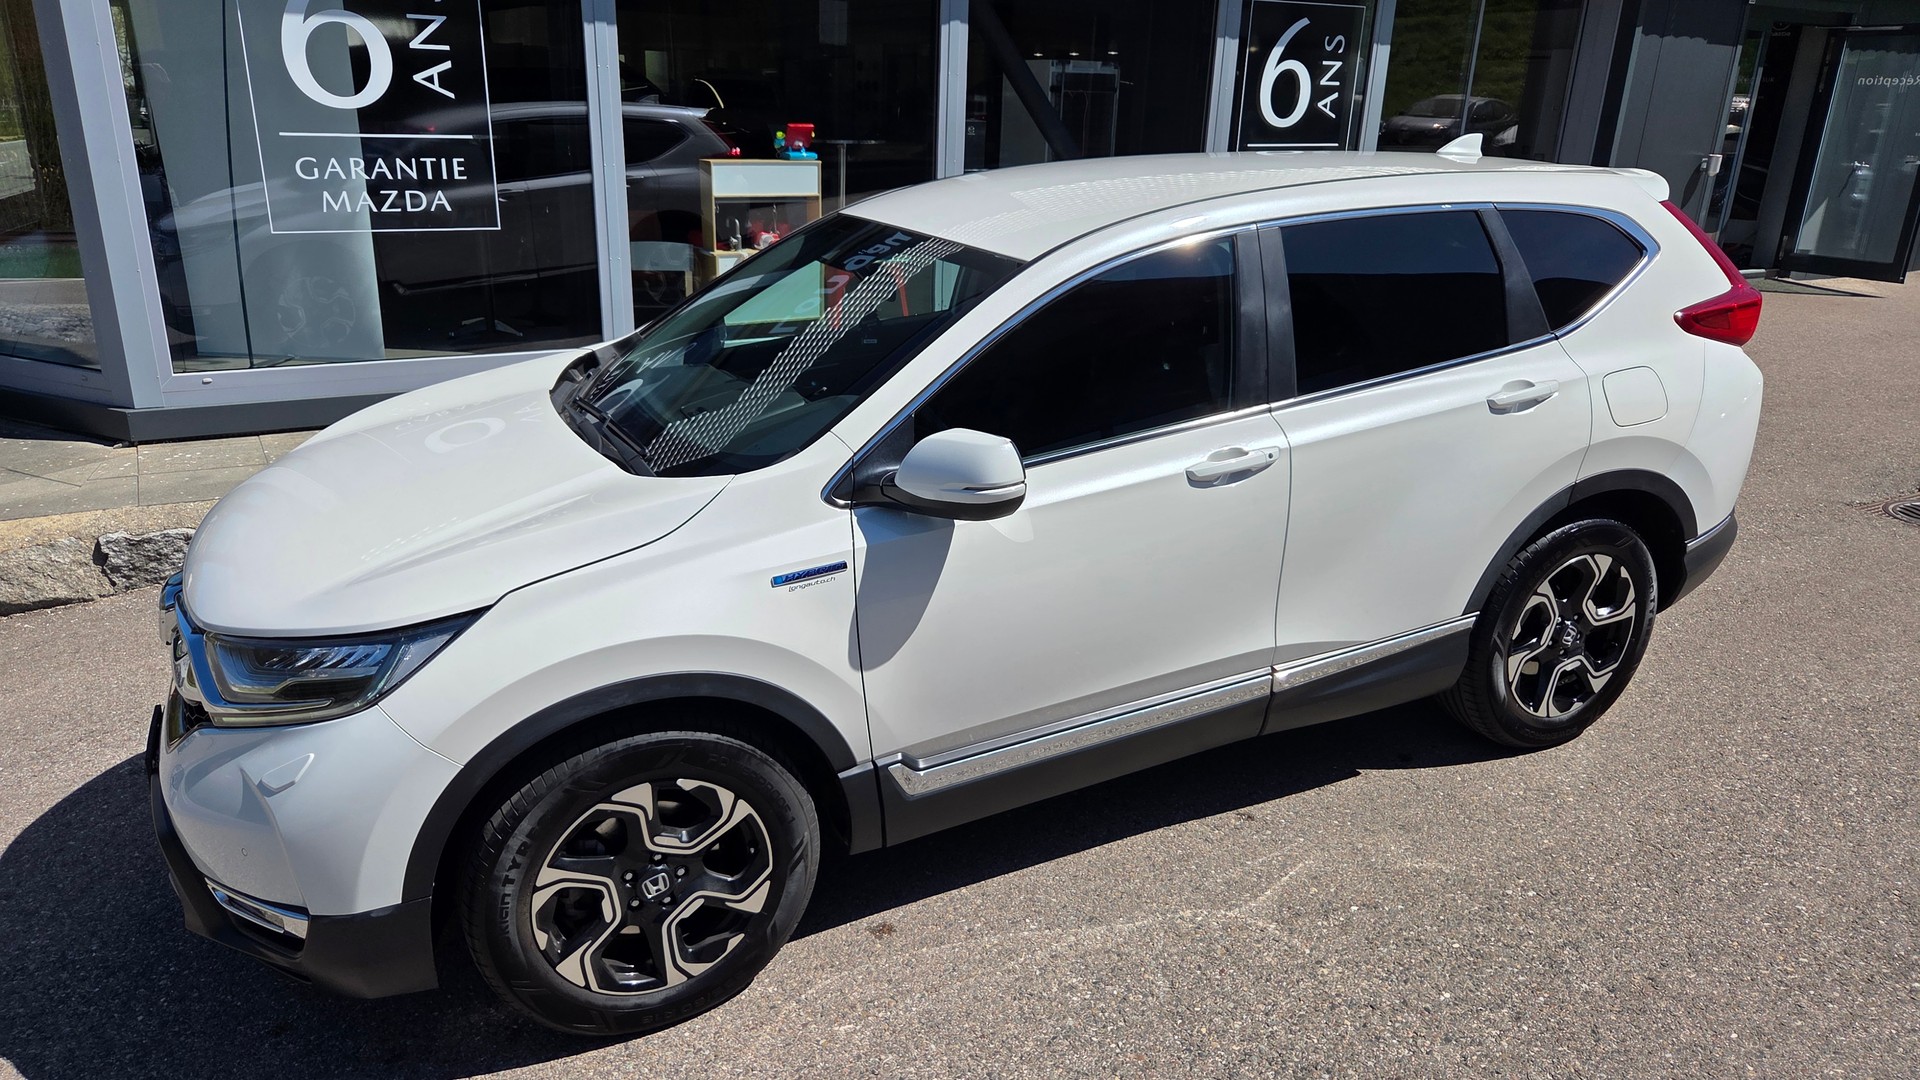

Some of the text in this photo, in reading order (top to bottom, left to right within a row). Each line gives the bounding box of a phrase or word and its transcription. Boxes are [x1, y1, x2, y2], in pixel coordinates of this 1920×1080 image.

[281, 0, 455, 109] 6 AN
[1260, 17, 1346, 128] 6 ANS
[295, 157, 468, 180] GARANTIE
[323, 190, 452, 213] MAZDA
